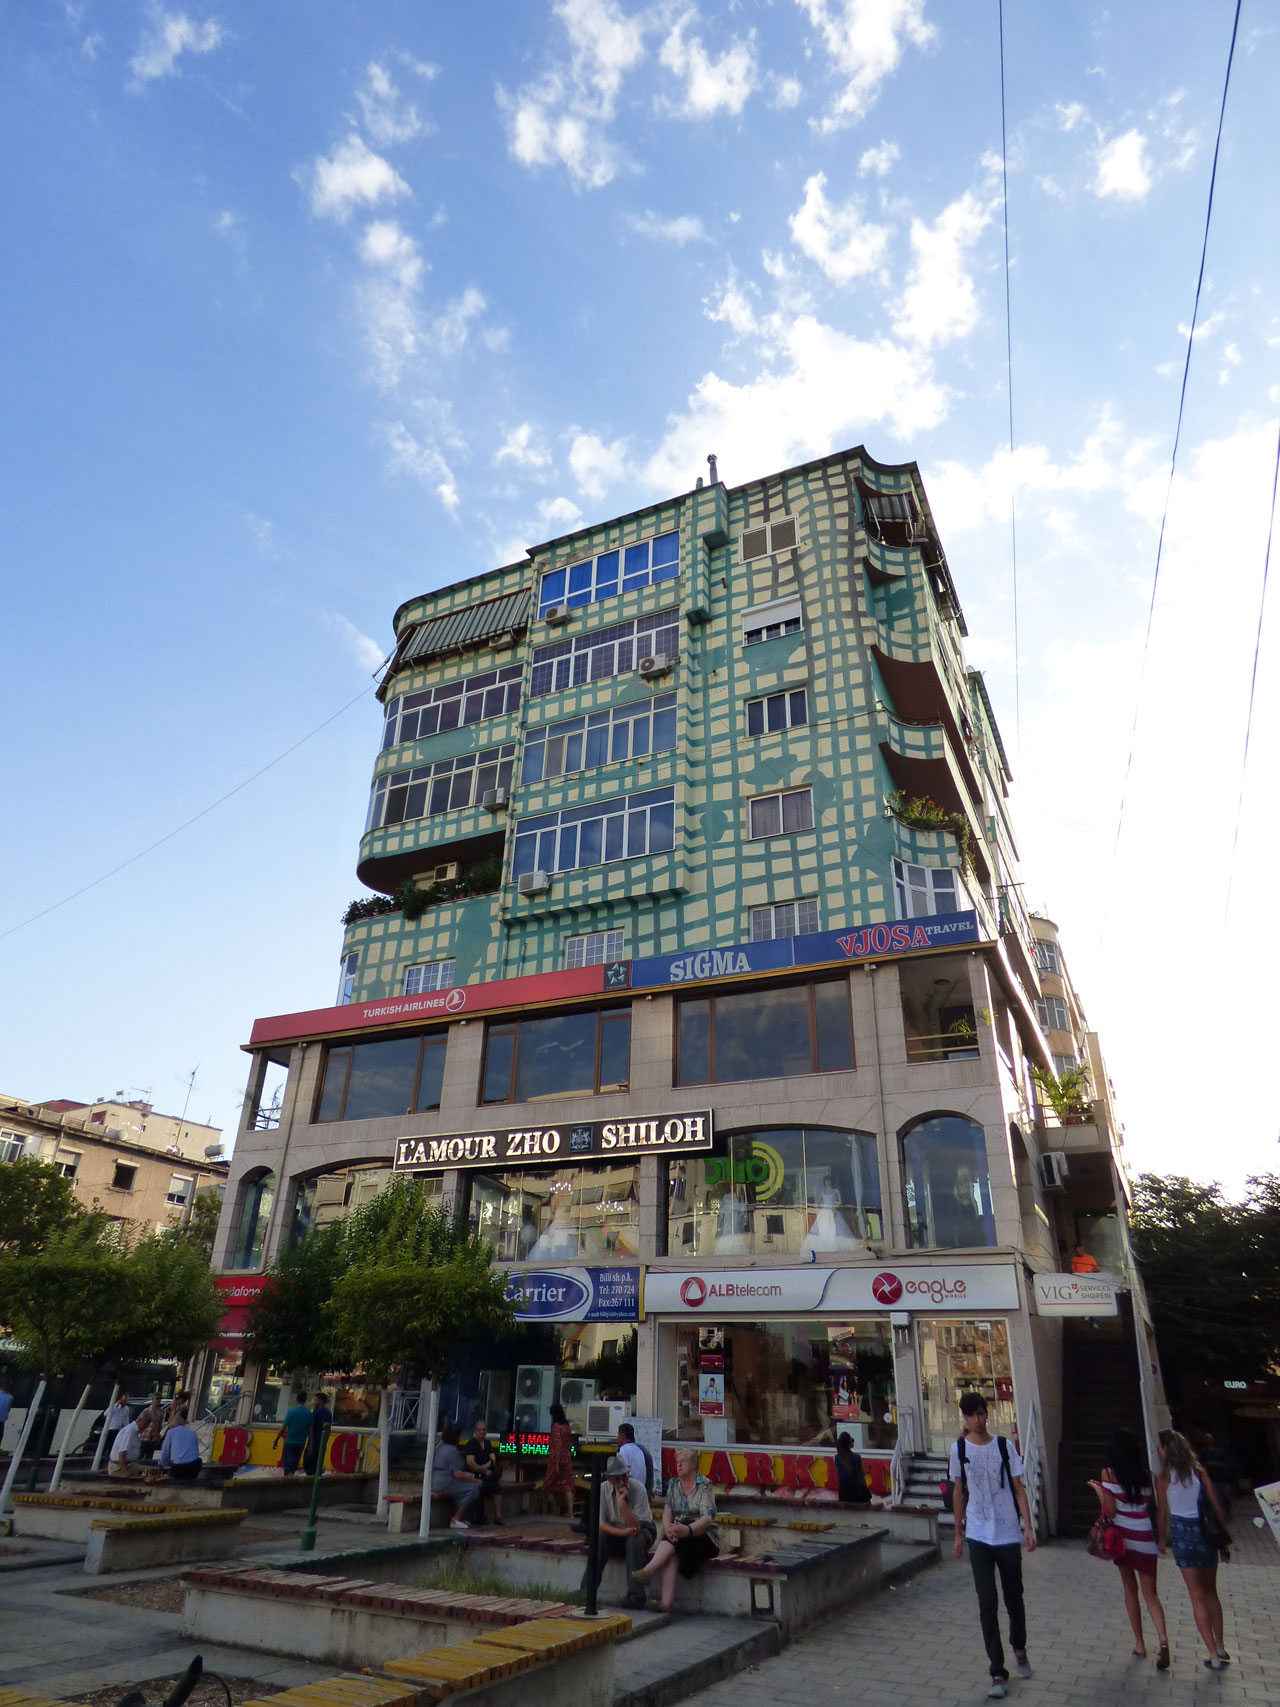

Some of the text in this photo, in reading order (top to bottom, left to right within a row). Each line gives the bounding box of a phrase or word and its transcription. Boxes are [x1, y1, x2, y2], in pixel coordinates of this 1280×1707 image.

[836, 921, 974, 956] VJOSA TRAVEL
[669, 950, 752, 982] SIGMA
[362, 998, 445, 1018] TURKISH AIRLINES
[397, 1117, 706, 1165] L'AMOUR ZHO SHILOH
[502, 1283, 567, 1302] Carrier
[610, 1285, 623, 1295] 270
[623, 1285, 635, 1295] 724
[708, 1283, 782, 1297] ALBtelecom
[904, 1278, 967, 1304] eagle
[1040, 1285, 1072, 1300] VIG
[1223, 1380, 1247, 1389] EURO
[217, 1427, 363, 1474] BG
